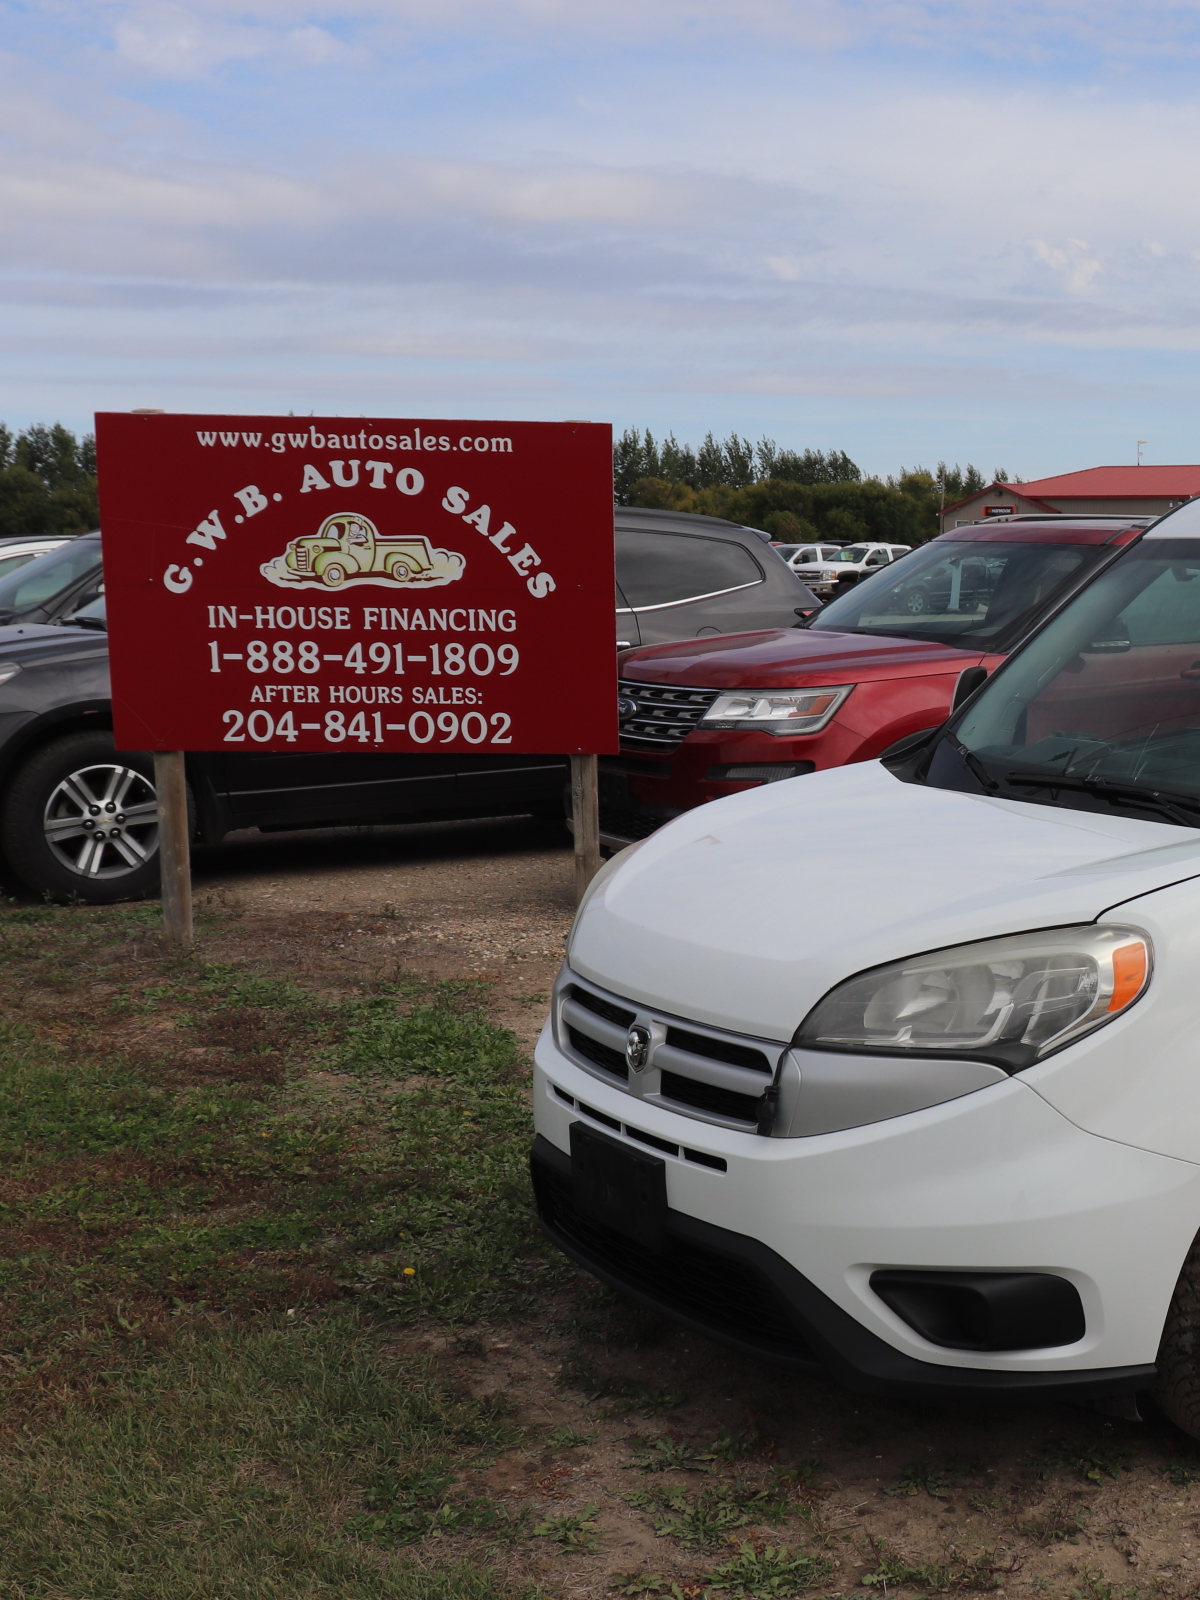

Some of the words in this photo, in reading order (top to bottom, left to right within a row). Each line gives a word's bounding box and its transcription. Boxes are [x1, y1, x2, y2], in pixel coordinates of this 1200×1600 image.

[196, 425, 514, 453] www.gwbautosales.com
[163, 484, 284, 594] G.W.B.
[299, 459, 426, 496] AUTO
[440, 486, 557, 599] SALES
[207, 605, 351, 630] IN-HOUSE
[362, 607, 517, 632] FINANCING
[207, 640, 520, 676] 1-888-491-1809
[250, 685, 320, 703] AFTER
[328, 685, 403, 704] HOURS
[411, 686, 483, 705] SALES:
[222, 709, 513, 744] 204-841-0902
